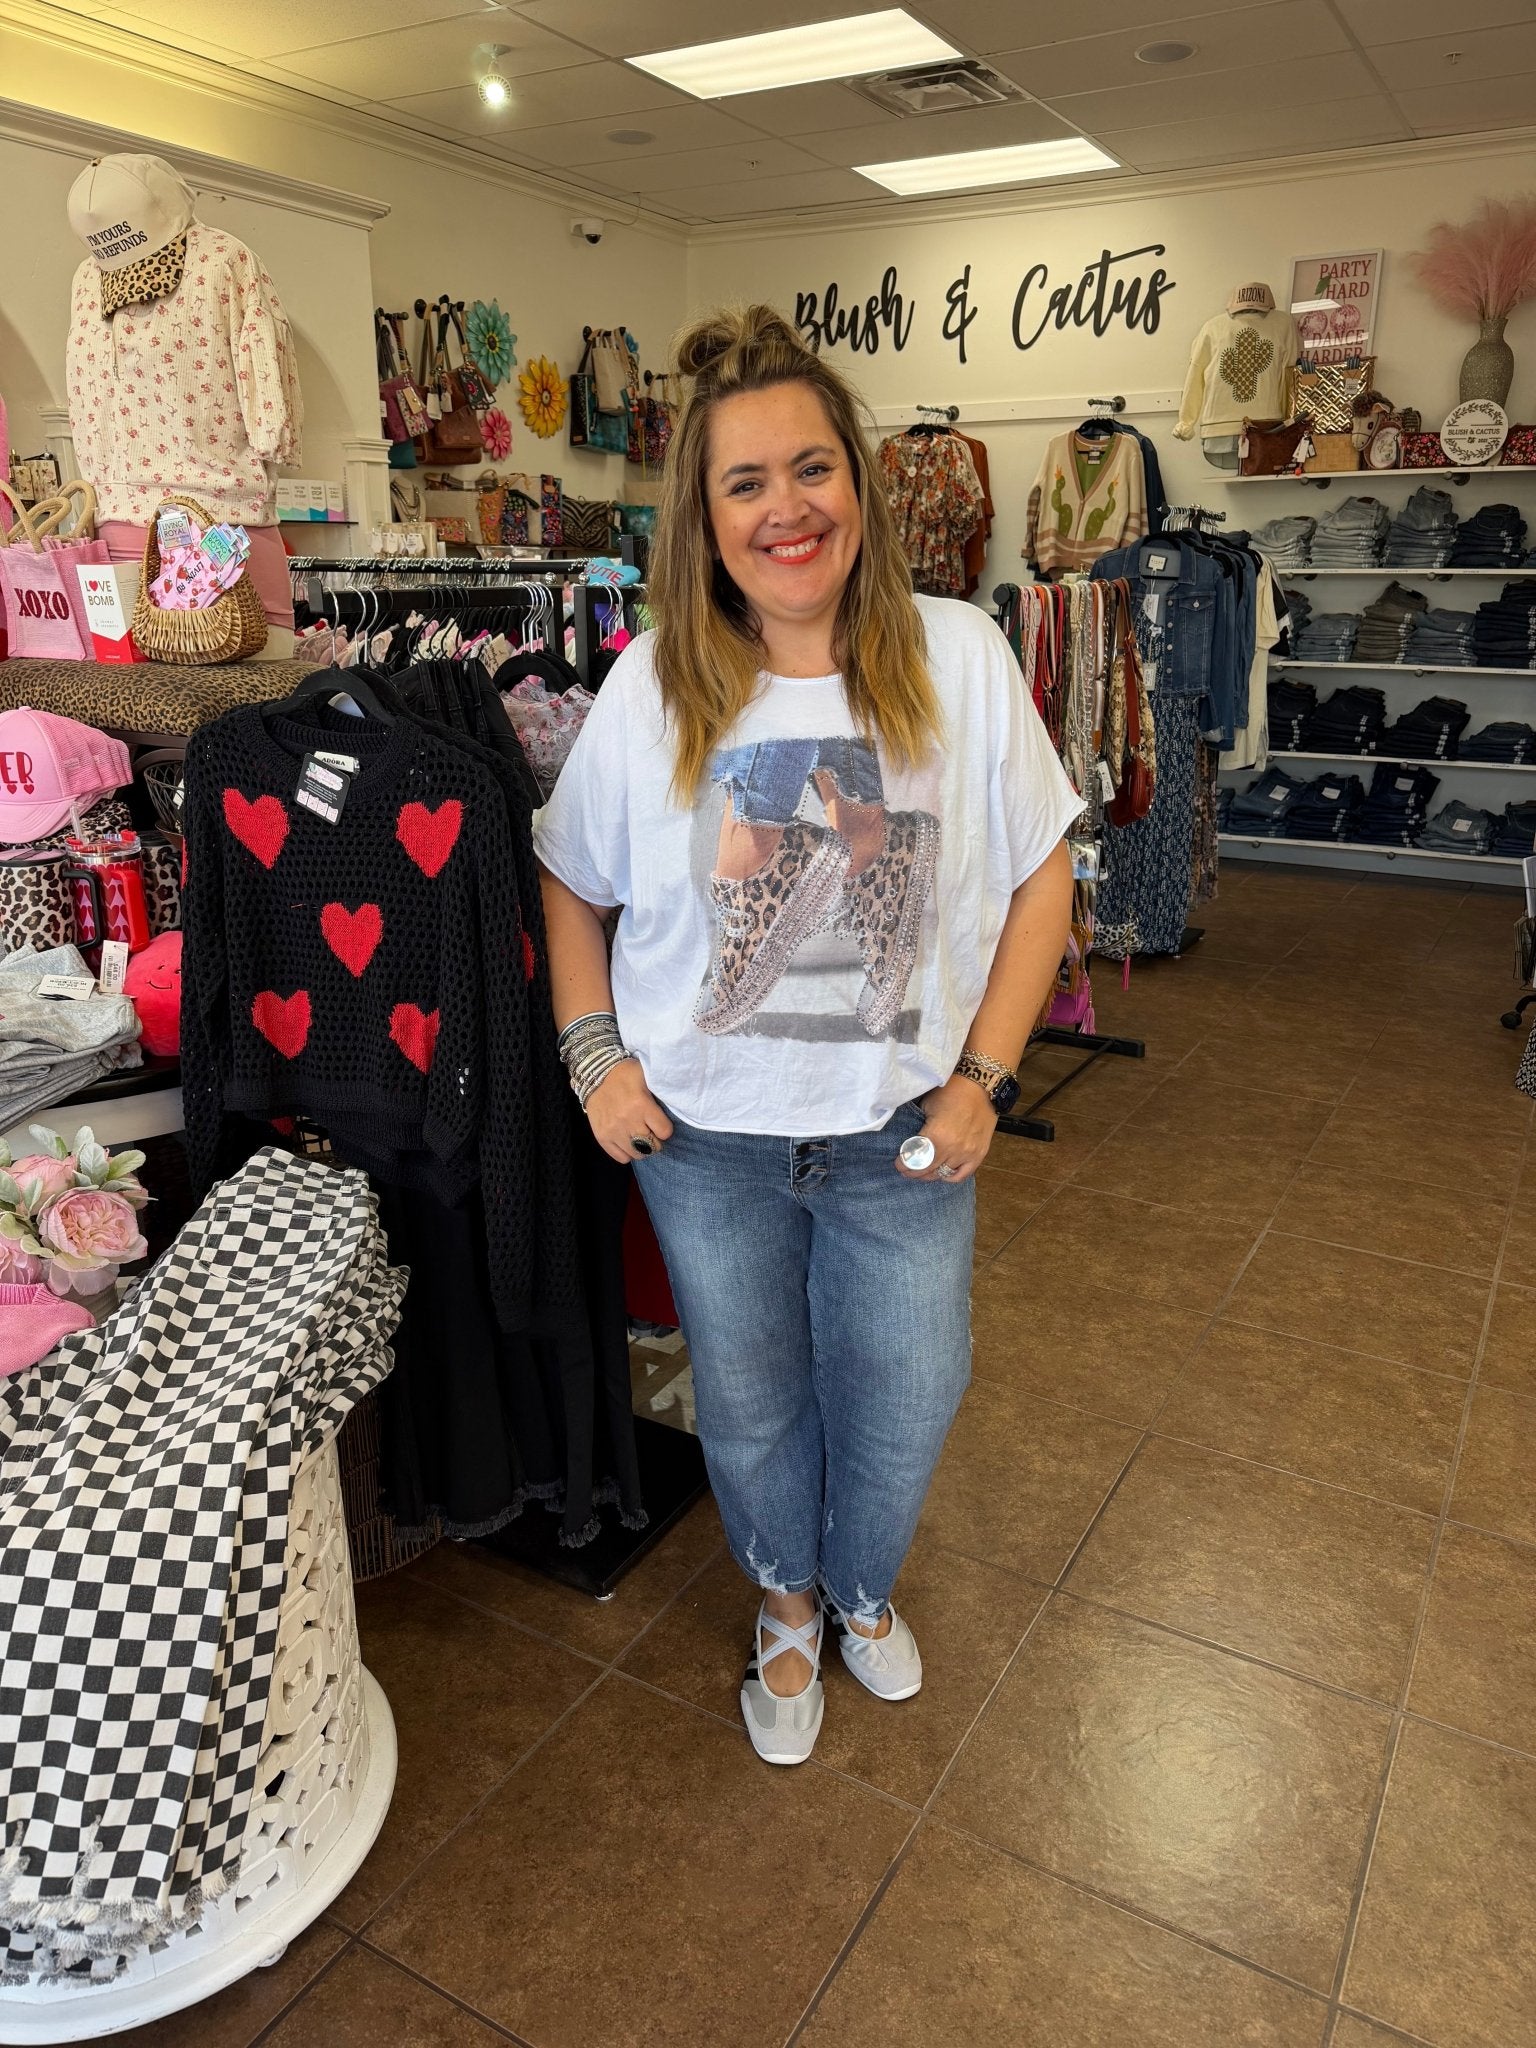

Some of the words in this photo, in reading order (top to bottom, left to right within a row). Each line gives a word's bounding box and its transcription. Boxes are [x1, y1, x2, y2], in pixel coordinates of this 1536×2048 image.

[97, 220, 132, 243] YOURS
[92, 248, 105, 260] NO
[102, 230, 148, 258] REFUNDS
[1320, 259, 1372, 280] PARTY
[1236, 287, 1265, 304] ARIZONA
[1326, 281, 1370, 300] HARD
[795, 266, 914, 355] Blush
[942, 264, 978, 364] &
[1012, 244, 1176, 350] Cactus
[1312, 329, 1365, 347] DANCE
[1447, 428, 1469, 436] BLUSH
[161, 520, 184, 531] LIVING
[163, 528, 187, 538] ROYAL
[584, 563, 625, 587] CUTIE
[14, 588, 70, 620] XOXO
[88, 595, 115, 606] BOMB
